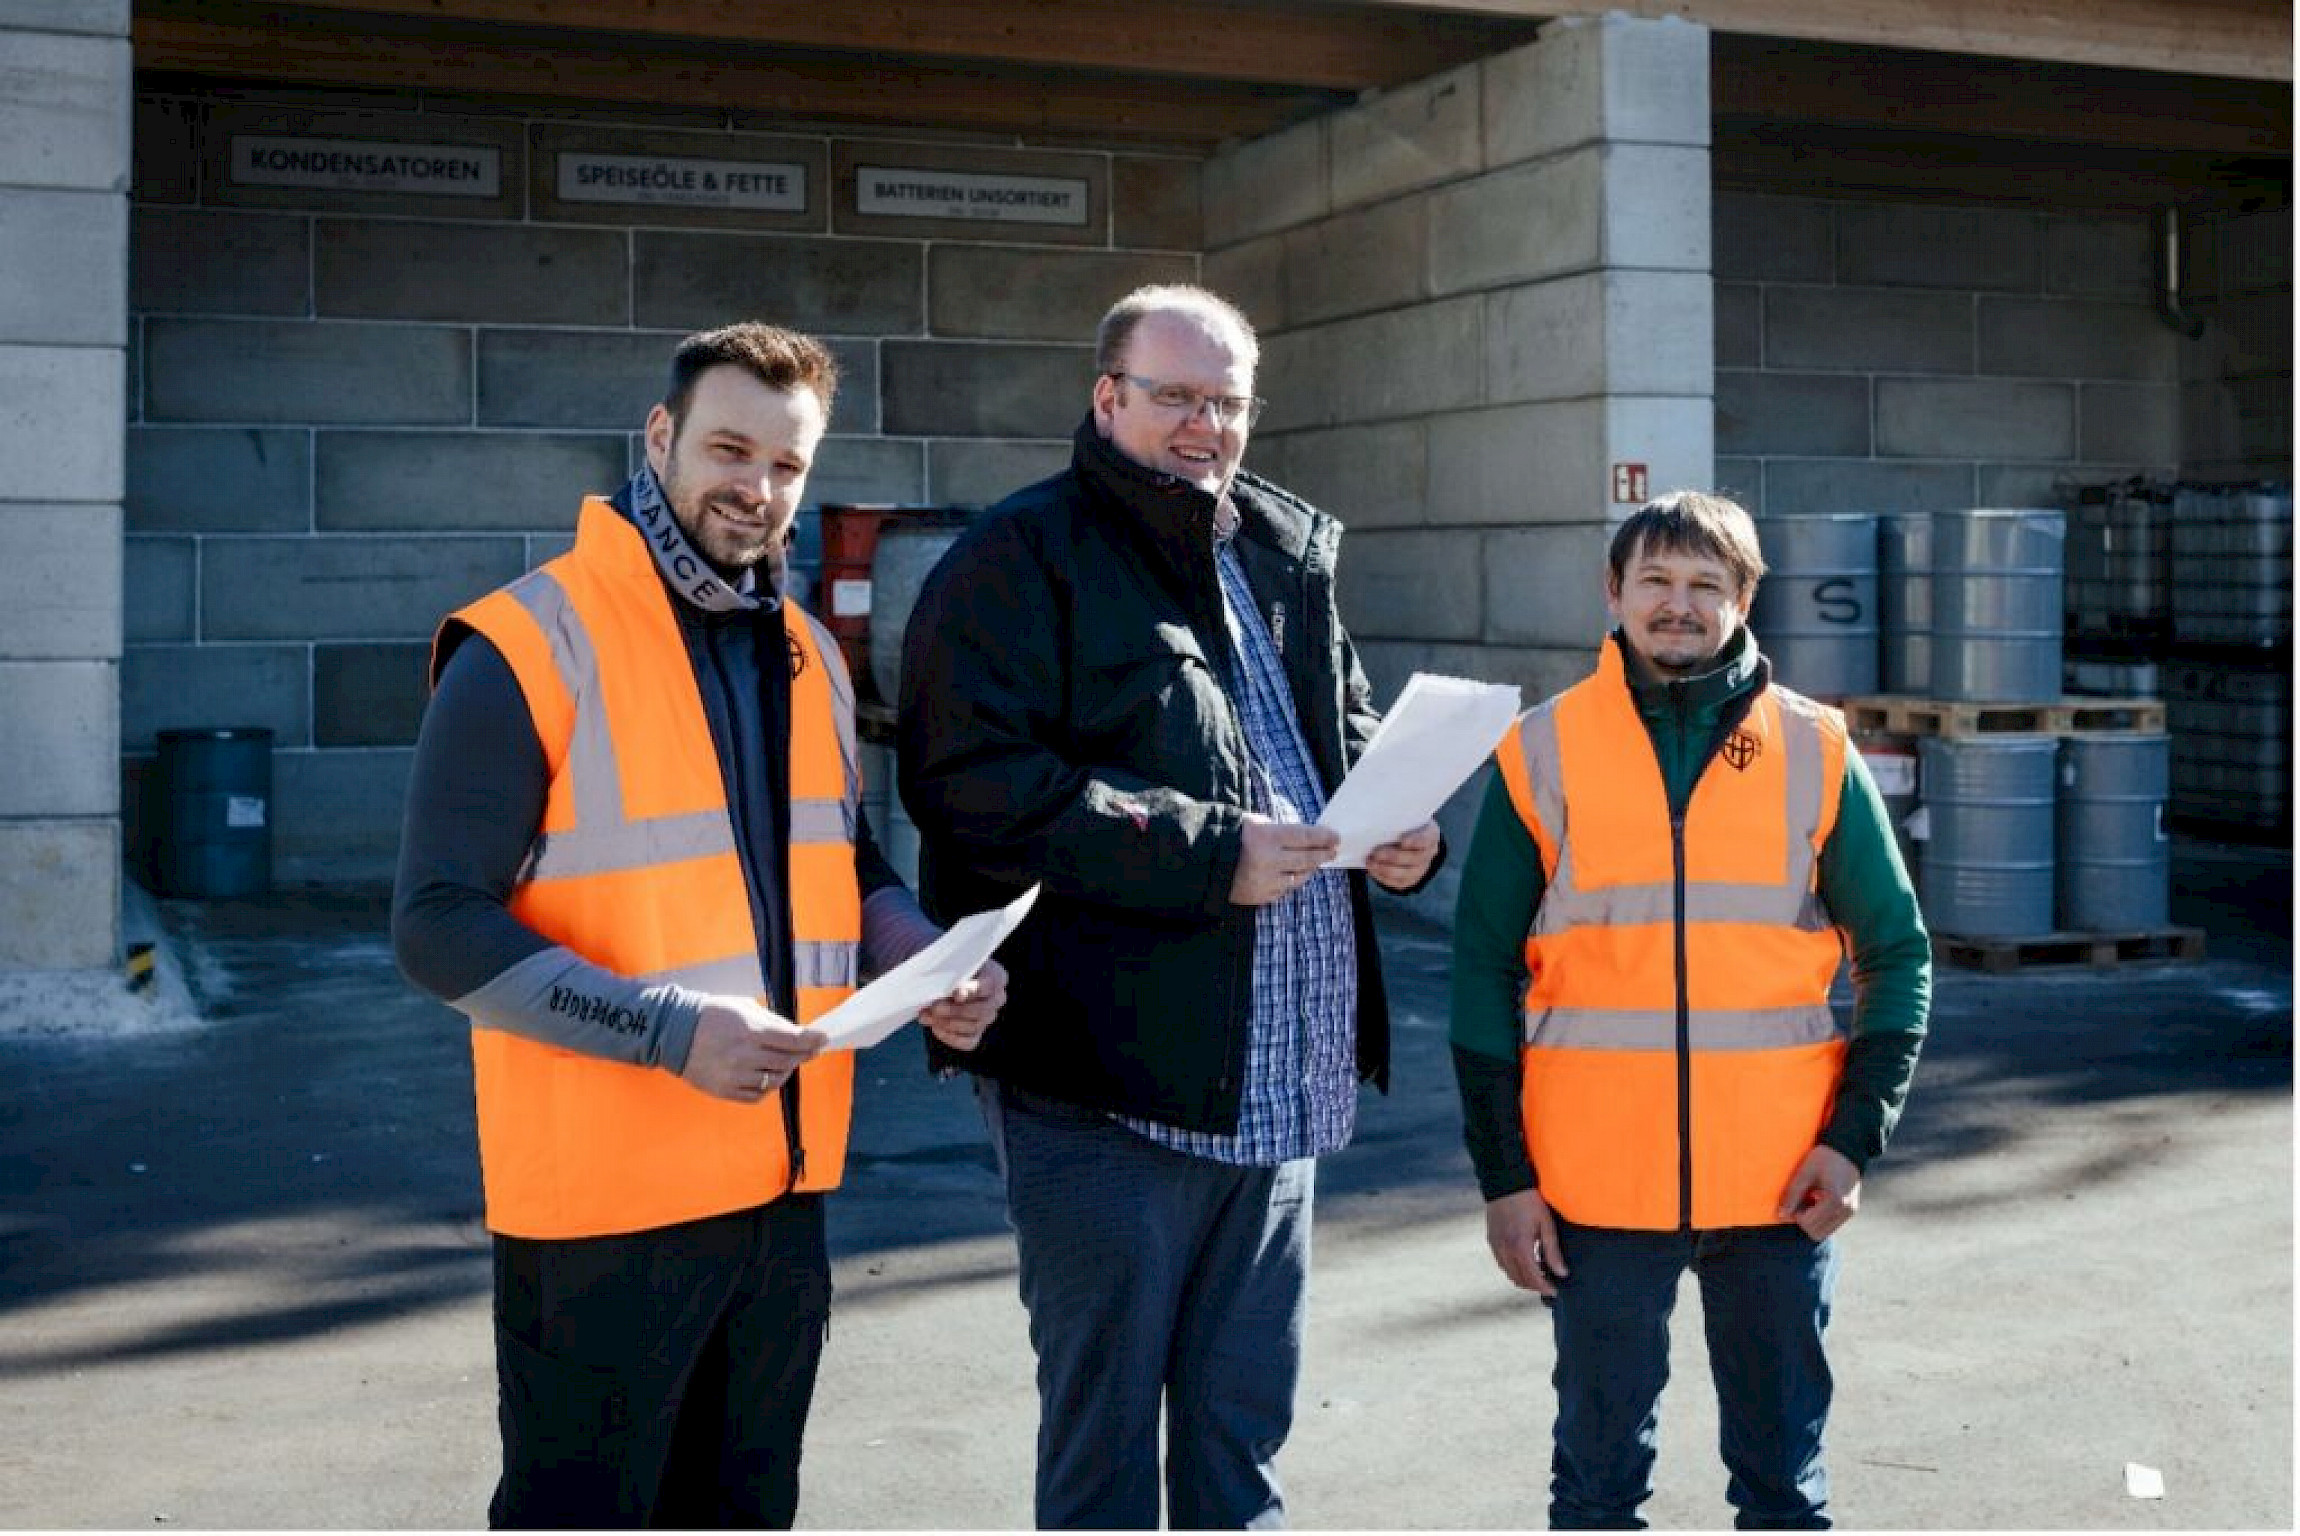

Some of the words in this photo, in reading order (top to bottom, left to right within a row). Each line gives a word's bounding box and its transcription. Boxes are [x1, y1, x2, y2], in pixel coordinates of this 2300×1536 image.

[250, 148, 480, 180] KONDENSATOREN
[576, 163, 697, 190] SPEISEÖLE
[703, 171, 718, 192] &
[725, 172, 790, 194] FETTE
[875, 182, 965, 202] BATTERIEN
[969, 188, 1073, 209] UNSORTIERT
[1812, 578, 1863, 624] S
